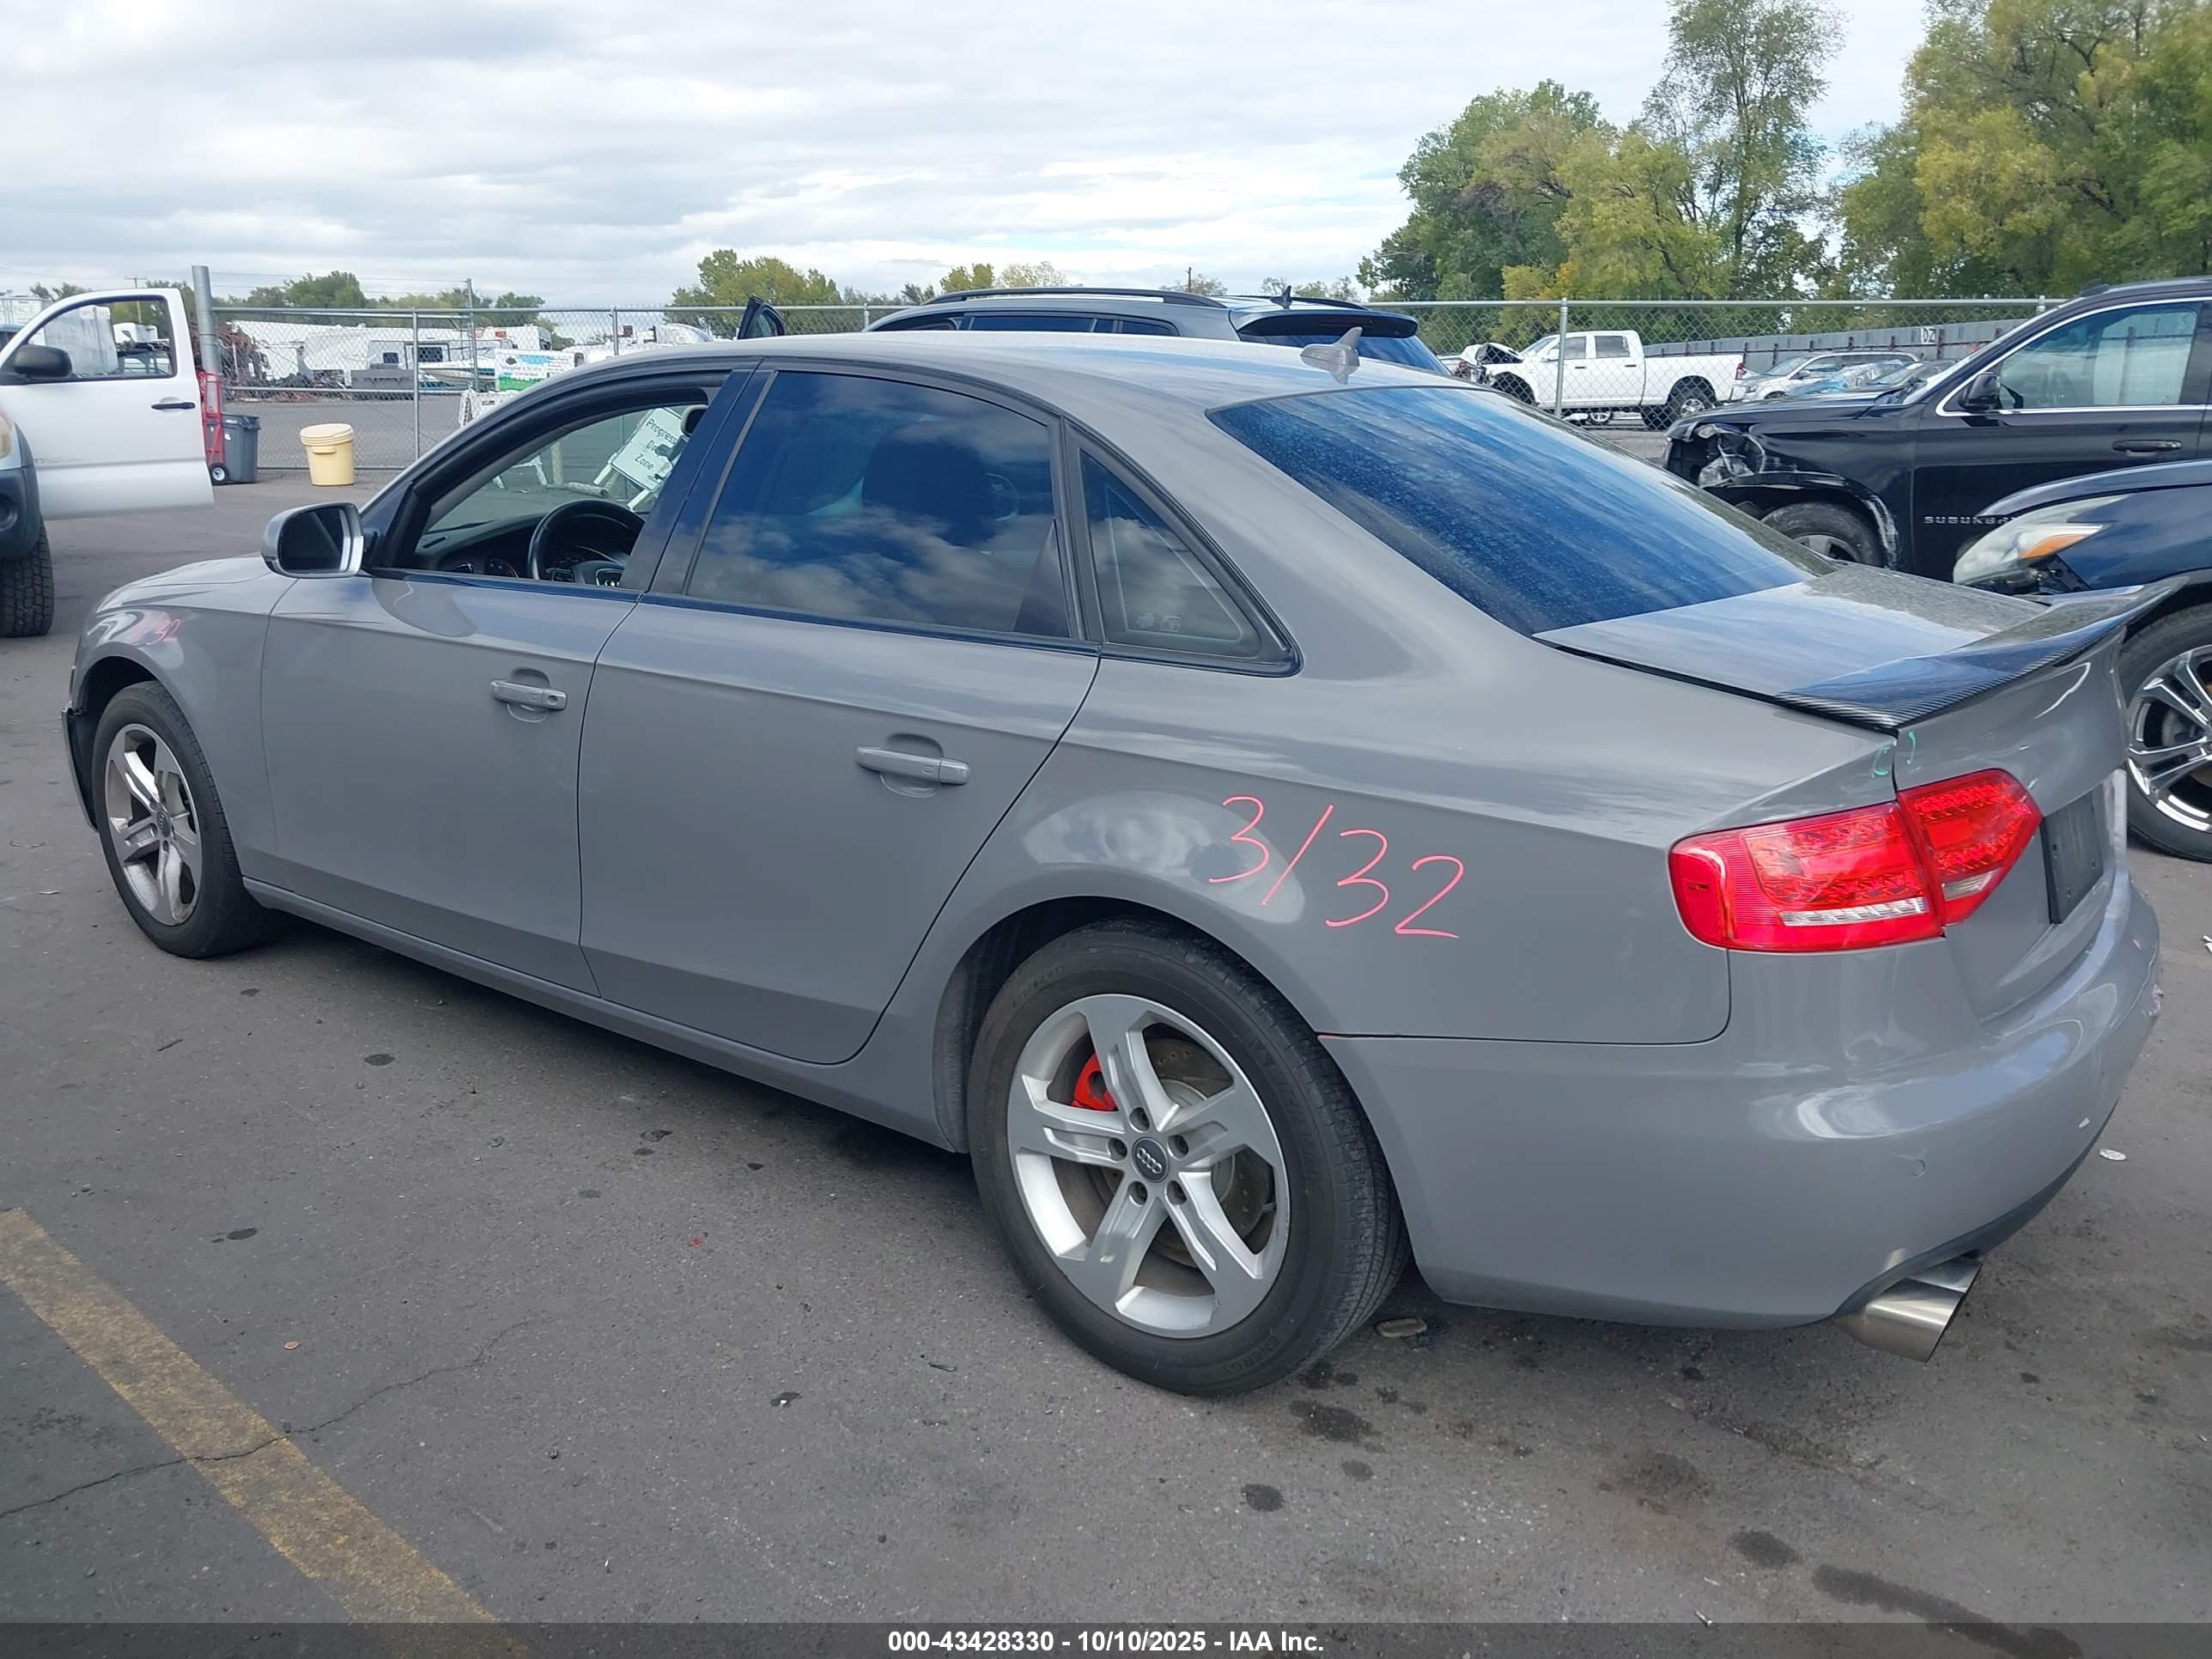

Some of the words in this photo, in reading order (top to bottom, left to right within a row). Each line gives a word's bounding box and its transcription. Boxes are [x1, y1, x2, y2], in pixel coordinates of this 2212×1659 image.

[646, 418, 678, 445] Progress
[635, 453, 654, 471] Zone
[1923, 516, 2016, 525] SUBURBA
[1208, 795, 1464, 939] 3/32
